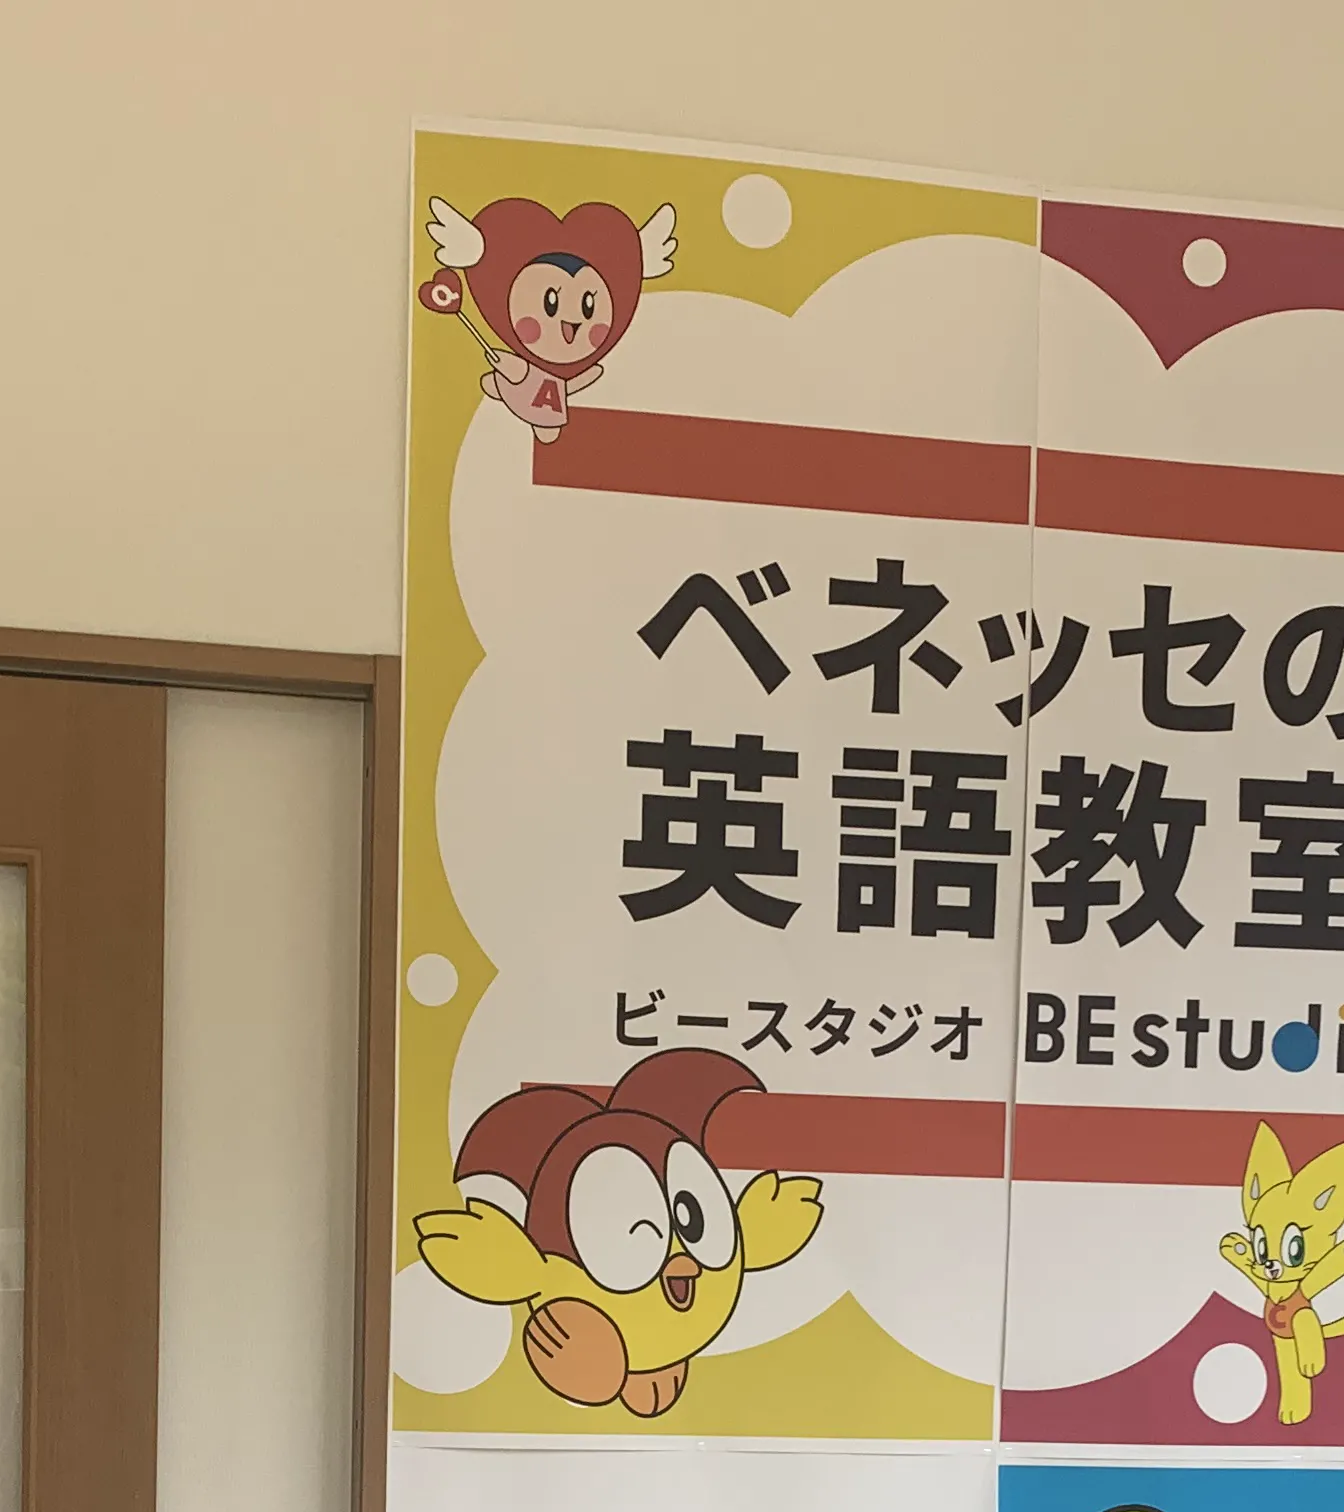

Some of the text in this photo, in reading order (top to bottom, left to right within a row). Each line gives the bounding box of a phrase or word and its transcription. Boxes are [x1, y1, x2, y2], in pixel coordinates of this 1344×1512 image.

[531, 379, 562, 413] A
[612, 988, 984, 1064] ビースタジオ
